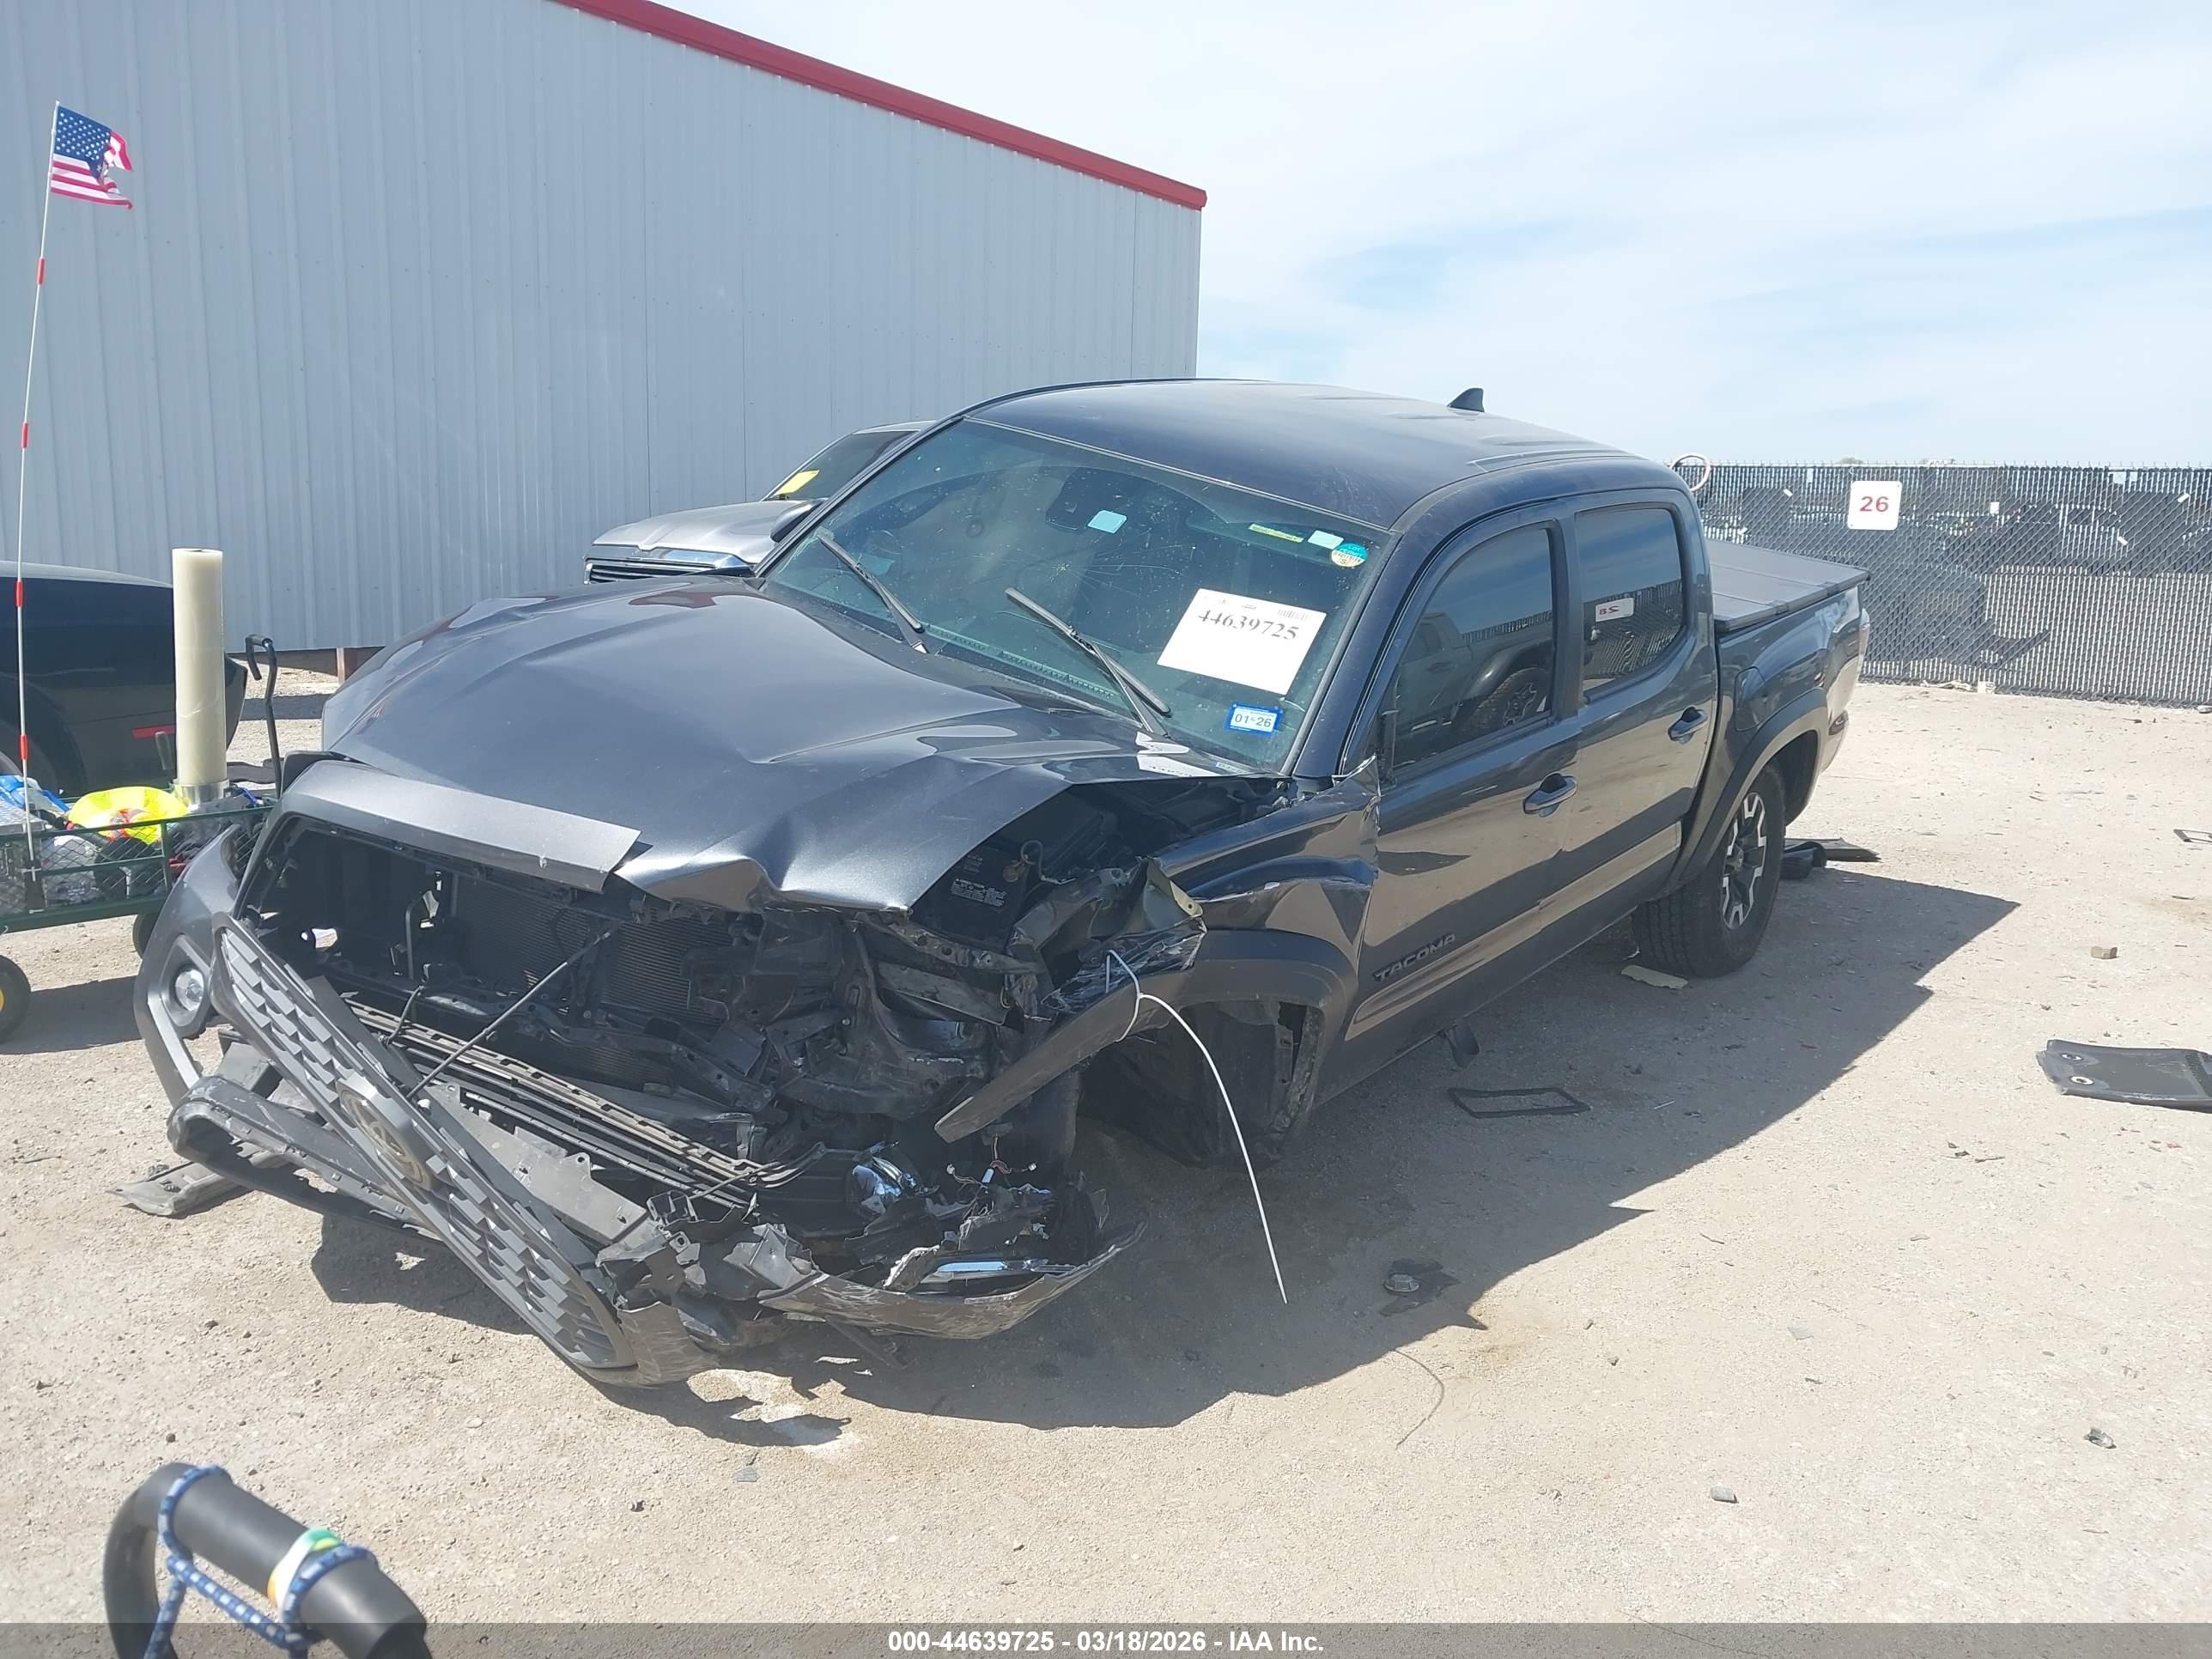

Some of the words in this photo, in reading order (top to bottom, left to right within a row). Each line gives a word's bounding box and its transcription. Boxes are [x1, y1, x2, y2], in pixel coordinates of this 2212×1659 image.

[1859, 495, 1890, 513] 26
[1198, 610, 1299, 640] 44639725
[1235, 714, 1249, 724] 01
[1255, 717, 1273, 727] 26
[1372, 933, 1456, 981] TACOMA
